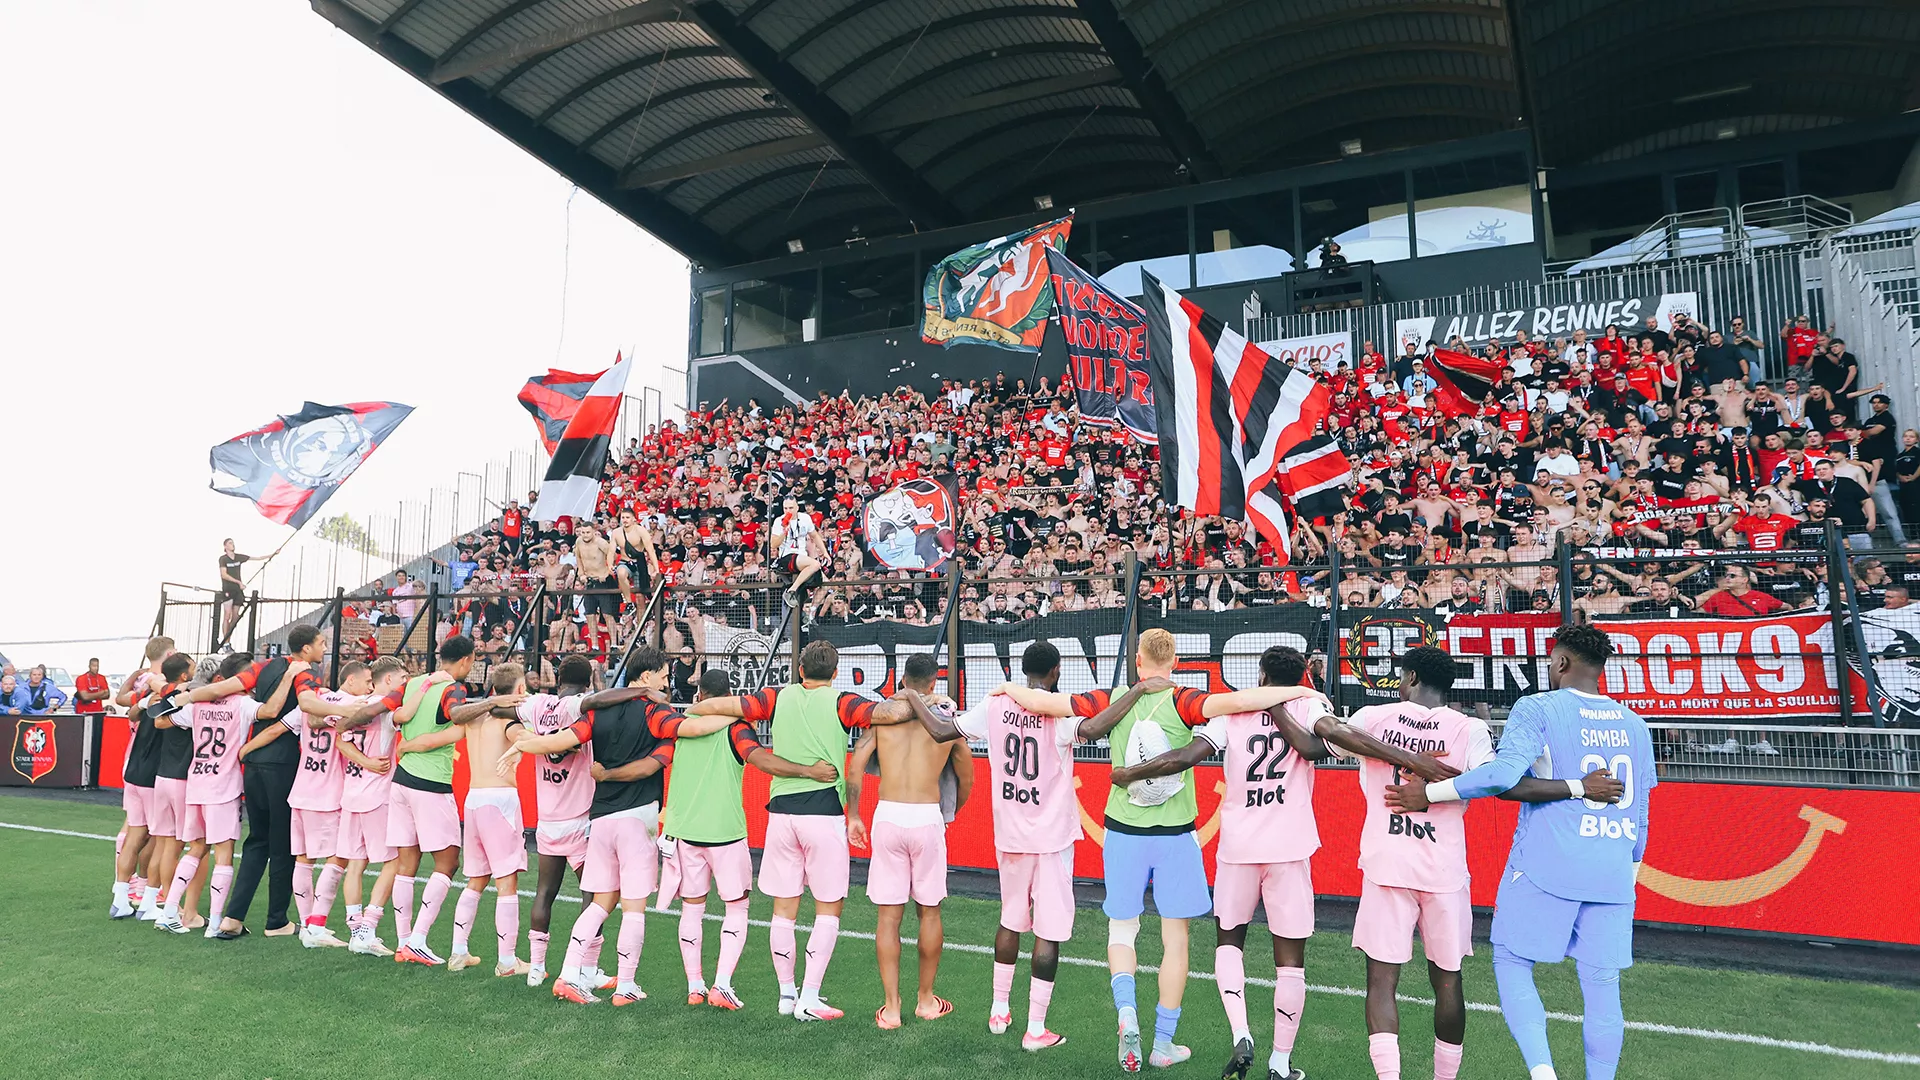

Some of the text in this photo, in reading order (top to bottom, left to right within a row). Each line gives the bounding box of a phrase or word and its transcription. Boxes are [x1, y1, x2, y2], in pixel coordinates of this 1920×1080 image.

[1444, 299, 1641, 344] ALLEZ RENNES
[1279, 342, 1346, 365] OCIOS
[1070, 355, 1155, 406] ULTR
[1604, 621, 1840, 695] RCK91
[1580, 707, 1624, 720] WINAMAX
[1660, 699, 1677, 709] LA
[1681, 698, 1719, 709] MORT
[1723, 698, 1752, 709] QUE
[1755, 697, 1774, 708] LA
[1781, 695, 1856, 708] SOUILLUE
[1398, 714, 1440, 731] WINAMAX
[195, 726, 227, 759] 28
[1381, 728, 1447, 754] MAYENDA
[1580, 728, 1630, 748] SAMBA
[1003, 733, 1039, 781] 90
[1246, 731, 1292, 782] 22
[1002, 781, 1040, 806] Blot
[1388, 813, 1437, 843] Blot
[1579, 814, 1637, 841] Blot
